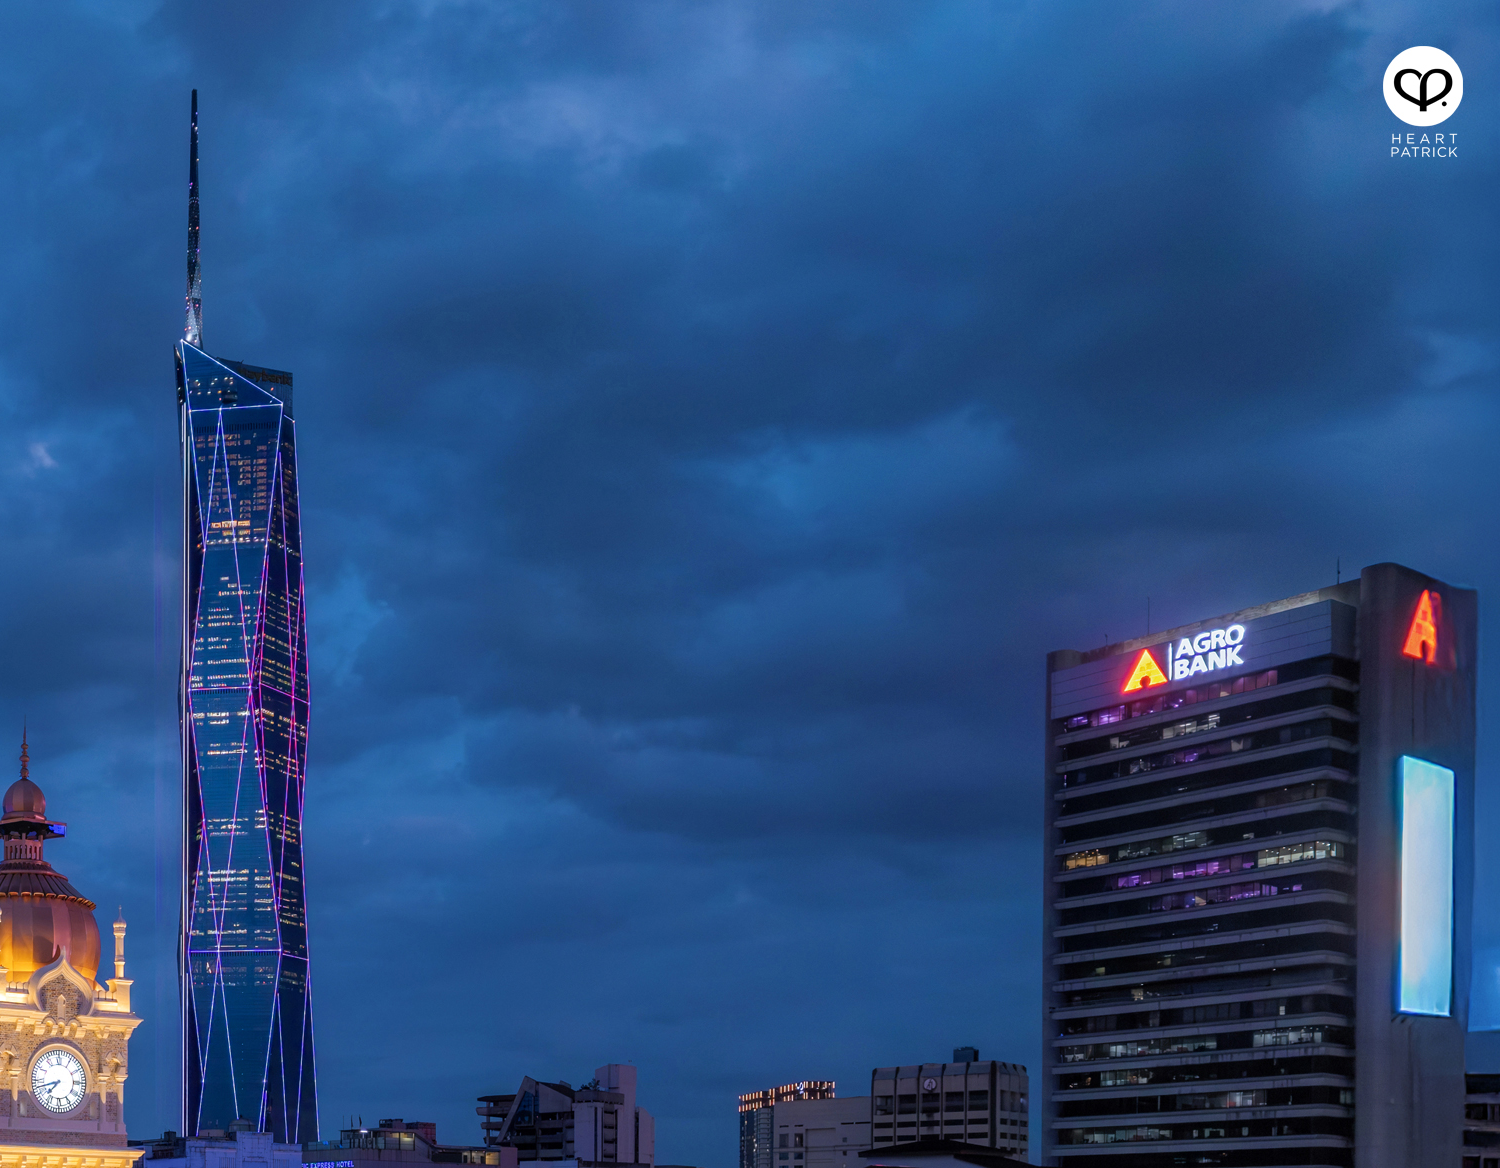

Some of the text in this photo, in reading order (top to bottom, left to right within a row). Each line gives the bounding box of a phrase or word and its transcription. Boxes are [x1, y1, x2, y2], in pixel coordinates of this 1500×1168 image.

[1175, 624, 1246, 659] AGRO
[1174, 644, 1245, 680] BANK
[336, 1160, 355, 1168] HOTEL
